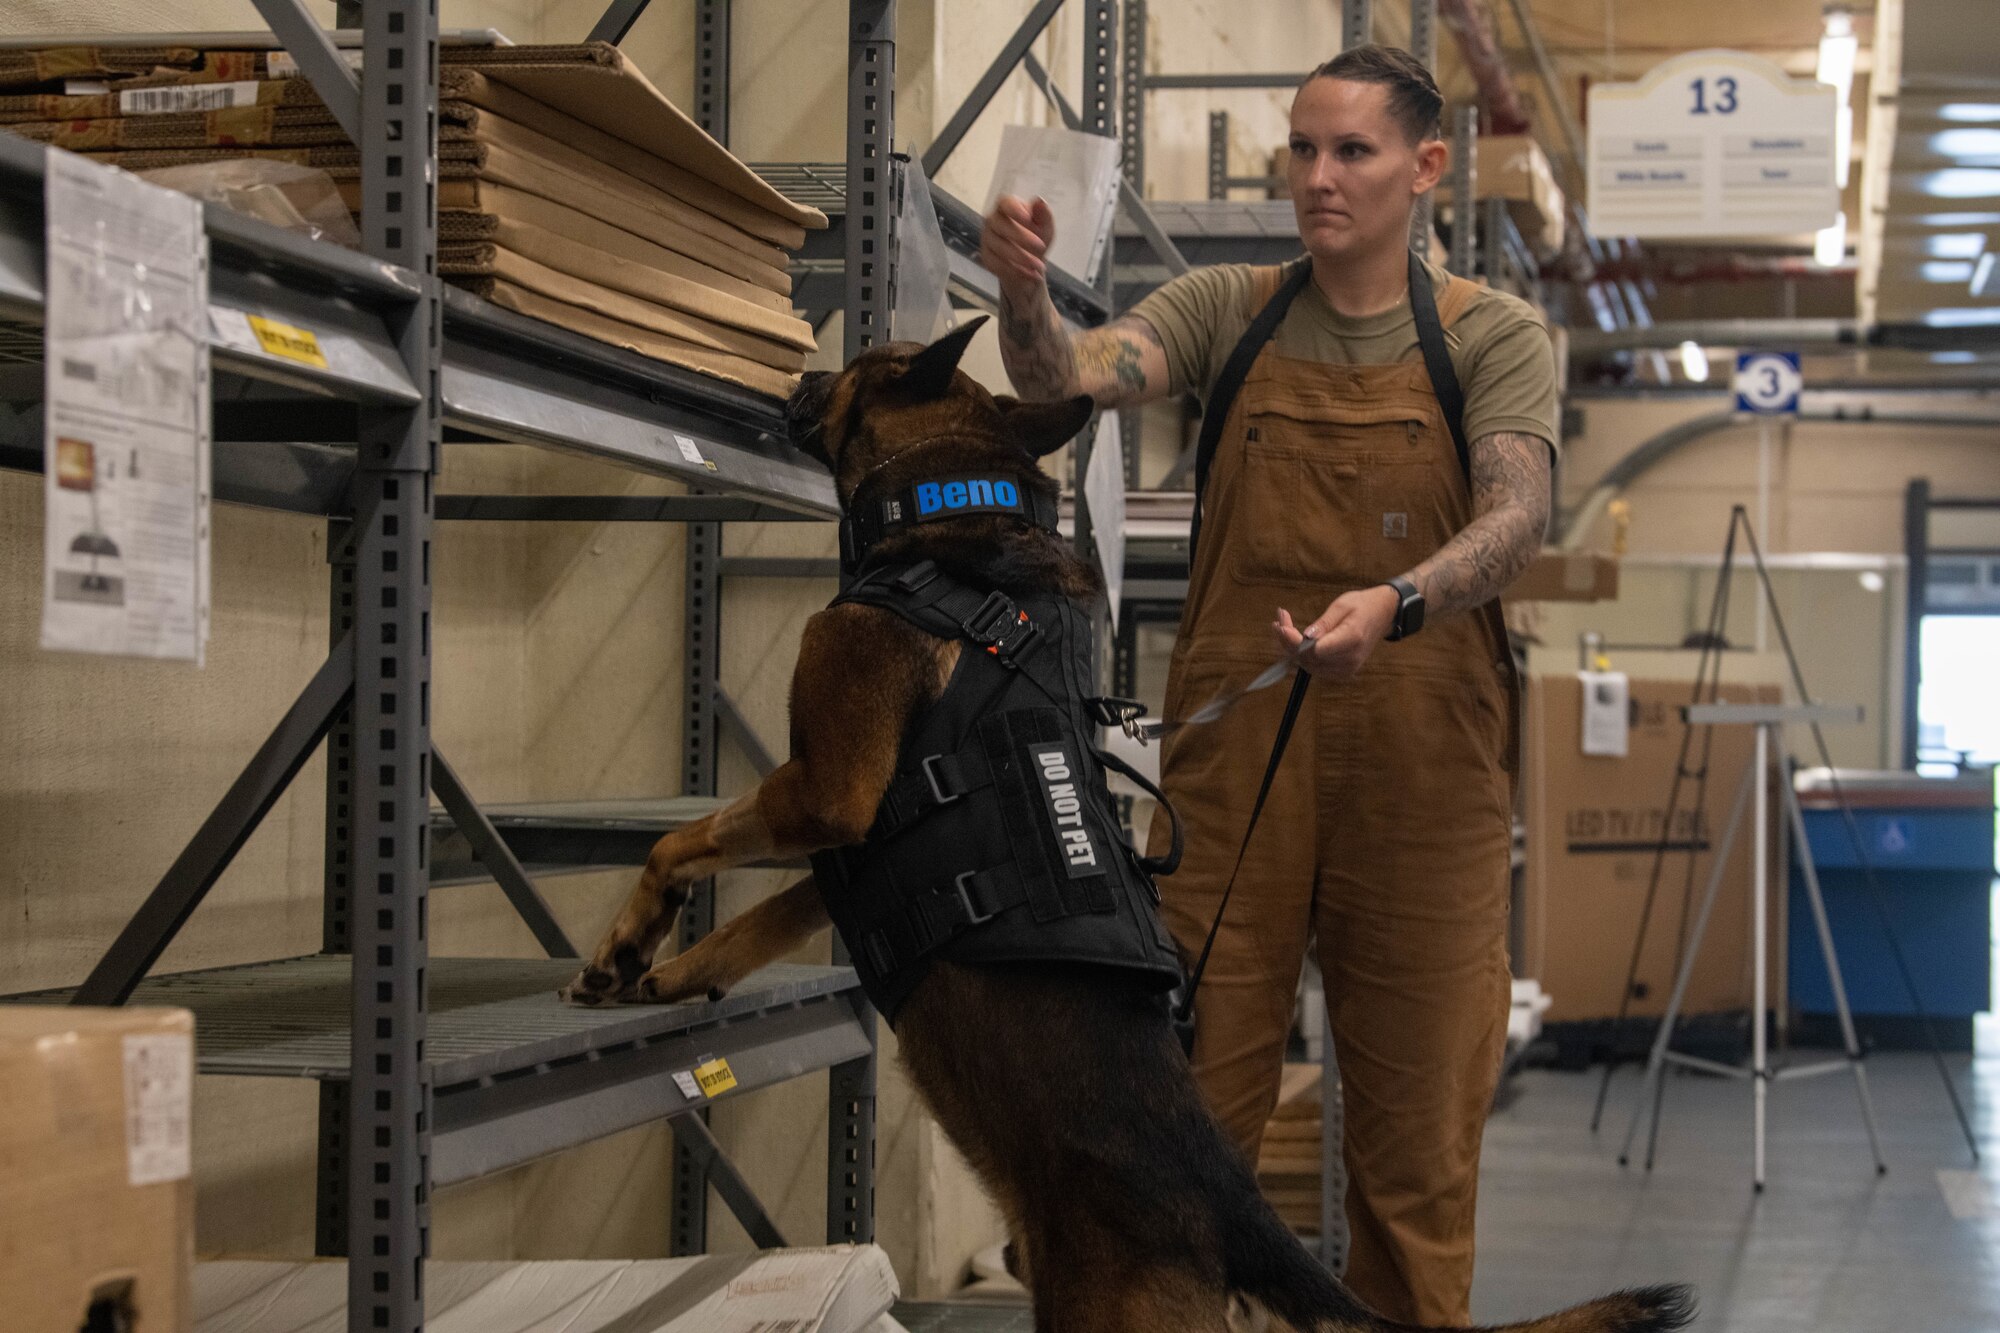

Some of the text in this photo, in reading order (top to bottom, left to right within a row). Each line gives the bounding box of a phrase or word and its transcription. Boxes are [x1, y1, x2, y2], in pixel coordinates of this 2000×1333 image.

[1688, 76, 1739, 115] 13
[1759, 366, 1780, 398] 3
[917, 479, 1018, 515] Beno
[1038, 752, 1096, 866] DO NOT PET
